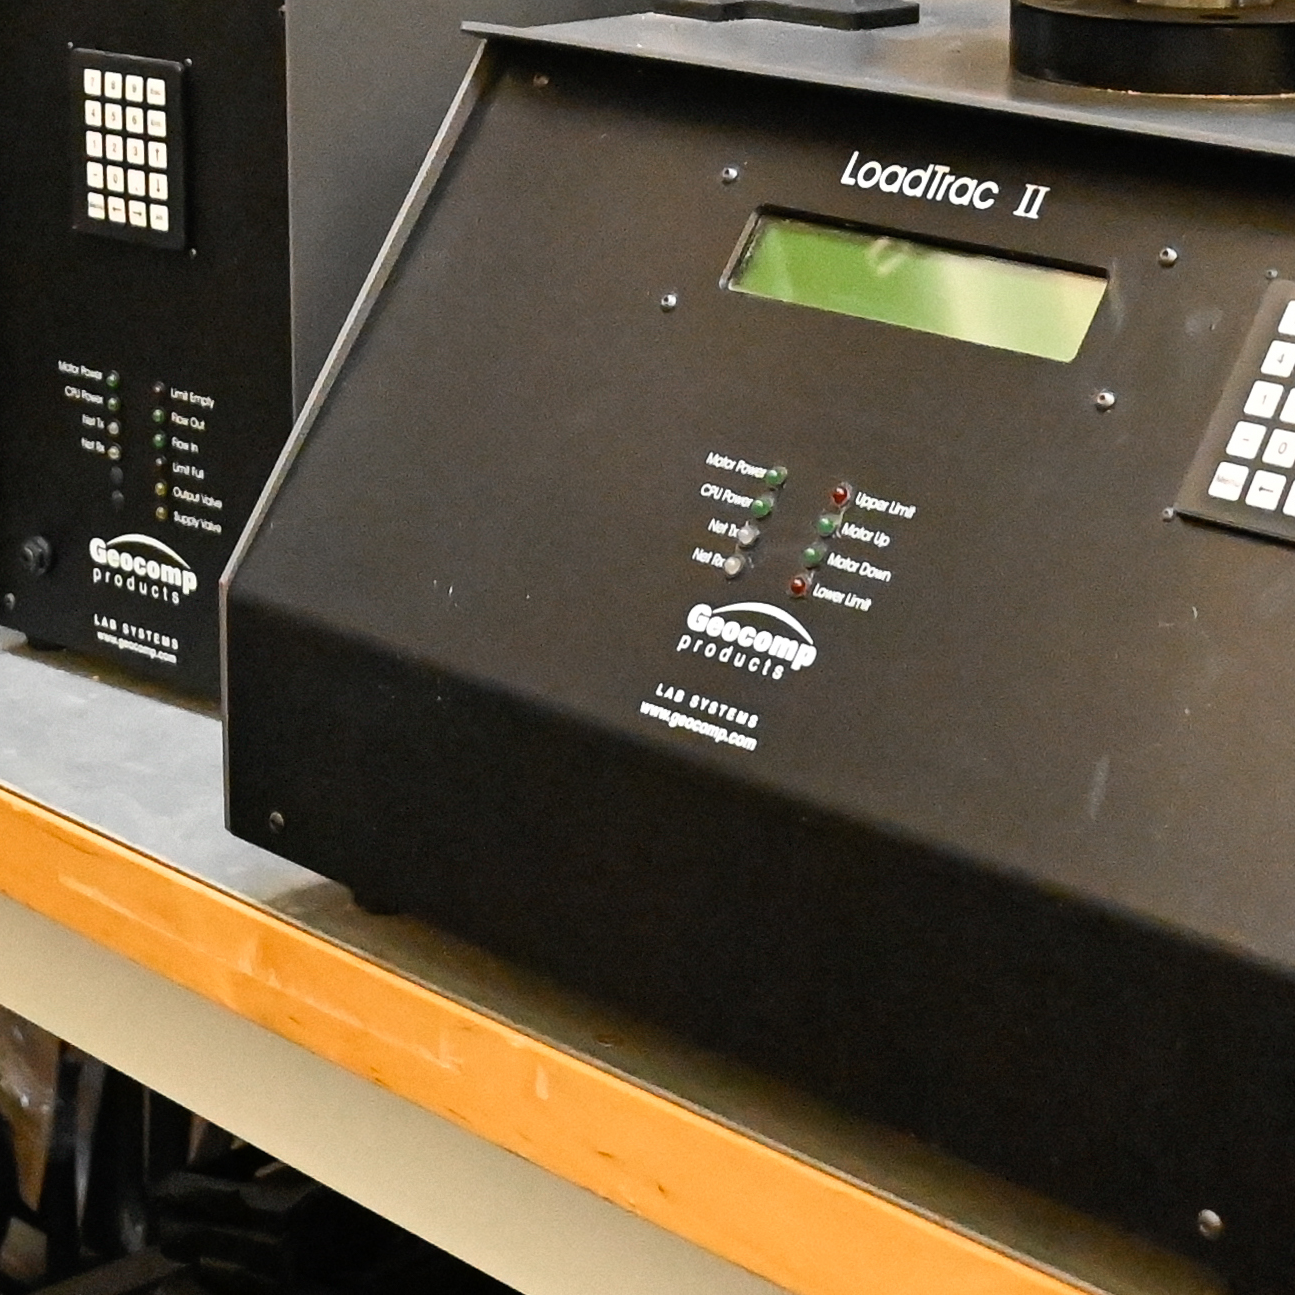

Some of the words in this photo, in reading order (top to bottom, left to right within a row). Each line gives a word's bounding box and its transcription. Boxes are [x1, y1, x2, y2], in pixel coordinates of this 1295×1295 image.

[840, 151, 999, 210] LoadTrac
[1013, 183, 1051, 219] II
[58, 360, 79, 375] Motor
[80, 365, 103, 381] Power
[1276, 353, 1285, 364] 4
[81, 390, 104, 405] Power
[170, 387, 188, 402] Limit
[189, 392, 215, 409] Empty
[190, 417, 206, 431] Out
[190, 441, 199, 454] In
[191, 466, 205, 480] Full
[706, 452, 736, 471] Motor
[735, 460, 768, 479] Power
[173, 486, 200, 503] Output
[700, 483, 723, 500] CPU
[721, 489, 754, 508] Power
[855, 492, 888, 512] Upper
[888, 498, 917, 519] Limit
[173, 511, 199, 529] Supply
[708, 518, 729, 535] Net
[841, 522, 874, 541] Motor
[873, 531, 891, 548] Up
[89, 537, 198, 595] Geocomp
[691, 547, 713, 564] Net
[827, 552, 860, 570] Motor
[859, 561, 892, 582] Down
[92, 567, 179, 605] products
[813, 583, 846, 604] Lower
[844, 592, 873, 612] Limit
[94, 613, 117, 630] LAB
[122, 622, 179, 650] SYSTEMS
[686, 603, 817, 671] Geocomp
[676, 634, 785, 680] products
[655, 683, 685, 703] LAB
[689, 694, 759, 728] SYSTEMS
[640, 701, 757, 751] www.geocomp.com
